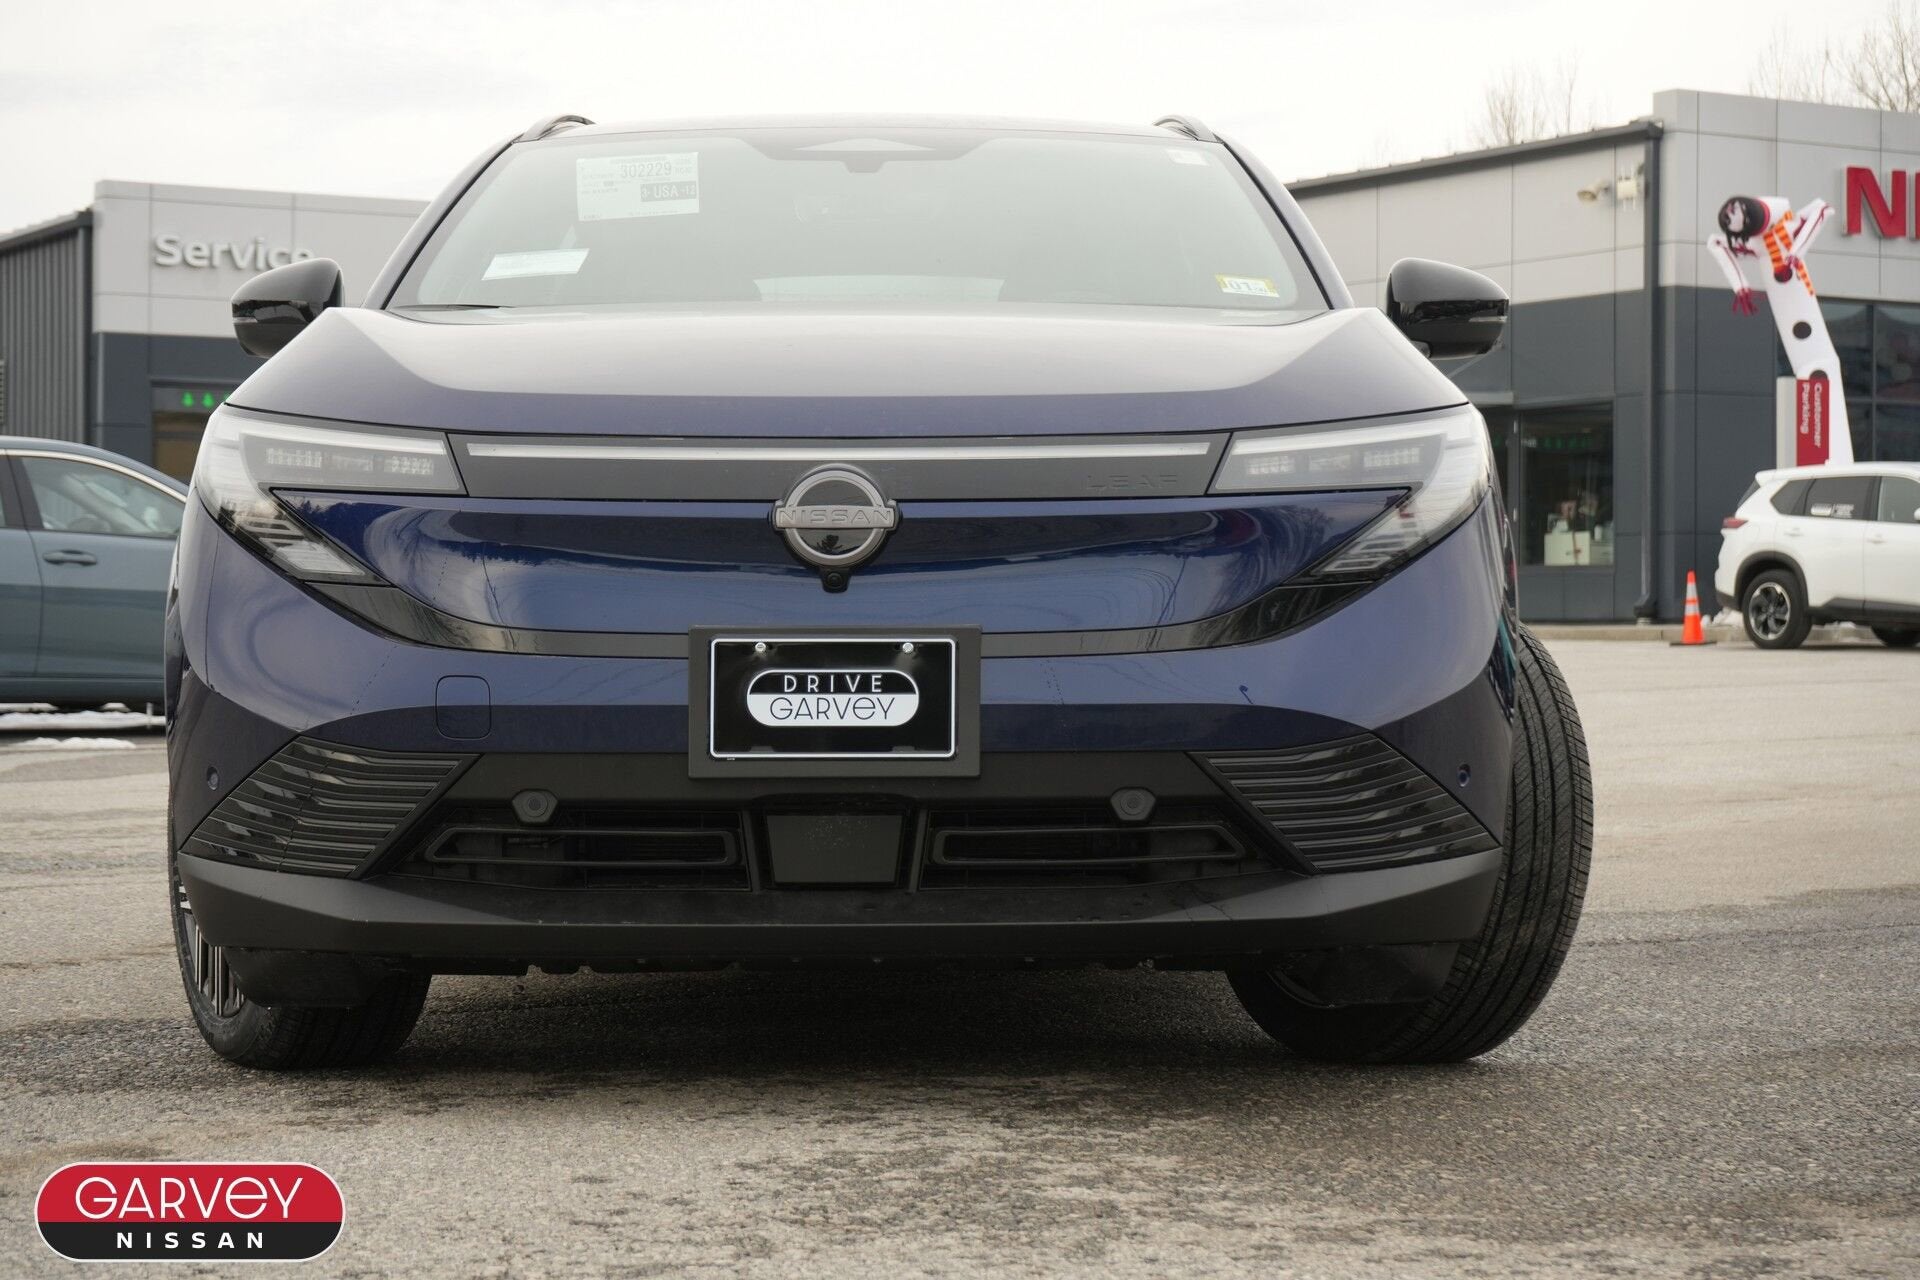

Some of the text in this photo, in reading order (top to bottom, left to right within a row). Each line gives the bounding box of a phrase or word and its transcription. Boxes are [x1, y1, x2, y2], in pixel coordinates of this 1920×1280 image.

[1800, 382, 1810, 434] Parking
[1813, 382, 1823, 448] Customer
[780, 508, 892, 526] NISSAN
[783, 674, 883, 693] DRIVE
